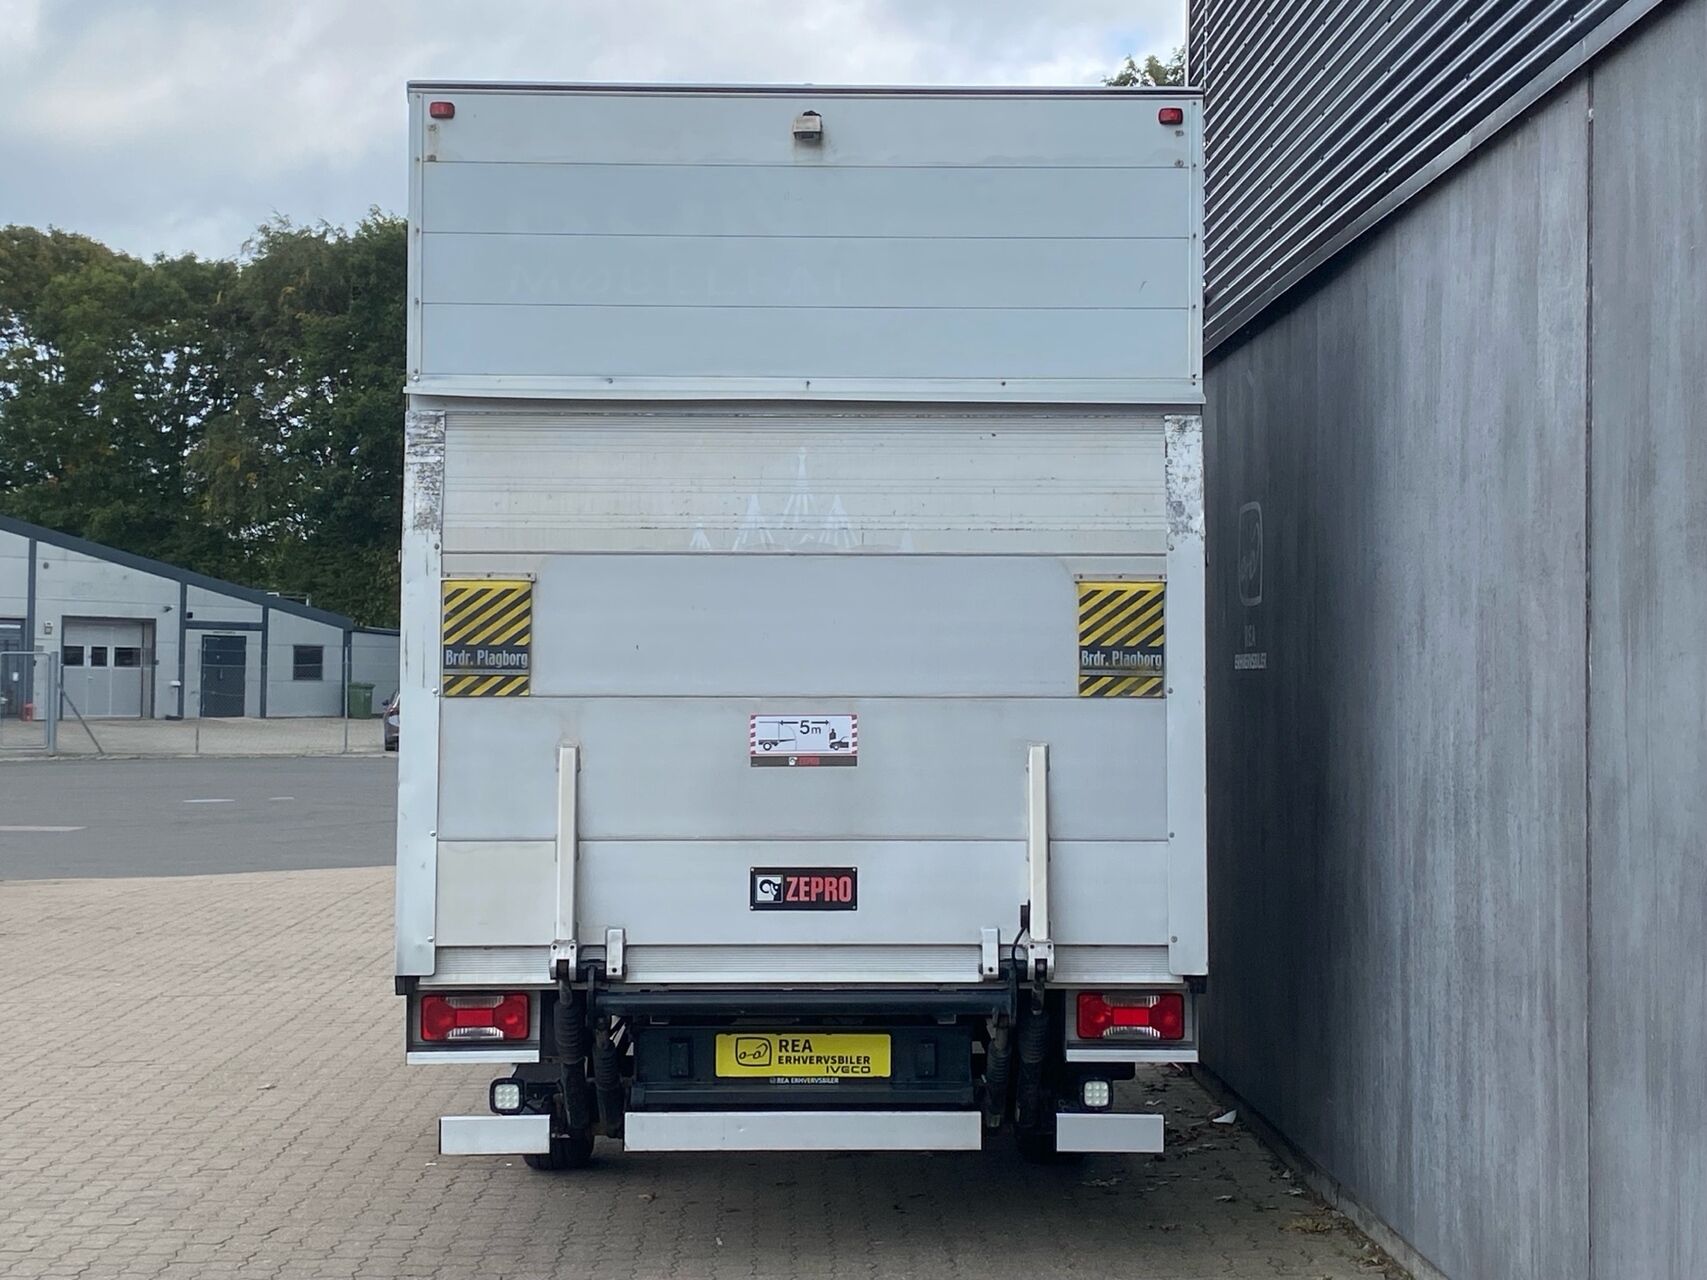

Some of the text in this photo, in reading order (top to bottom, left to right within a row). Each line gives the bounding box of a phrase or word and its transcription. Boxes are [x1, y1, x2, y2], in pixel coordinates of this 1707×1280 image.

[445, 649, 528, 668] Brdr. Plagborg
[1081, 650, 1162, 669] Brdr. Plagborg
[786, 876, 852, 902] ZEPRO
[778, 1039, 813, 1053] REA
[778, 1055, 870, 1065] ERHVERVSBILER
[826, 1065, 871, 1074] IVECO
